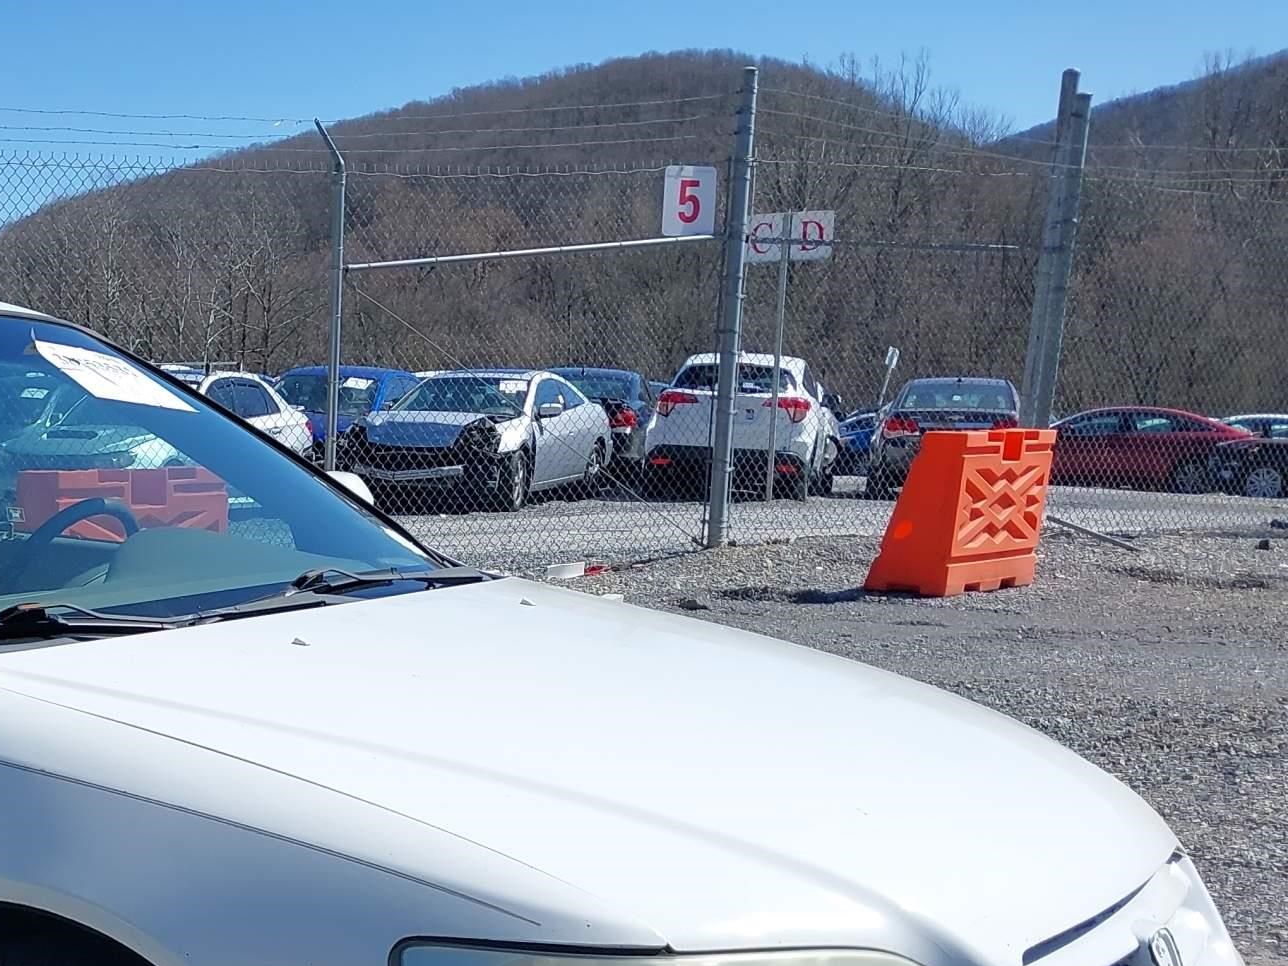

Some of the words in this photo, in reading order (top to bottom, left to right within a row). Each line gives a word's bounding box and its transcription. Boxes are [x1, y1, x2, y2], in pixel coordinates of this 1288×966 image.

[677, 179, 701, 224] 5
[750, 222, 774, 254] C
[799, 220, 825, 252] D
